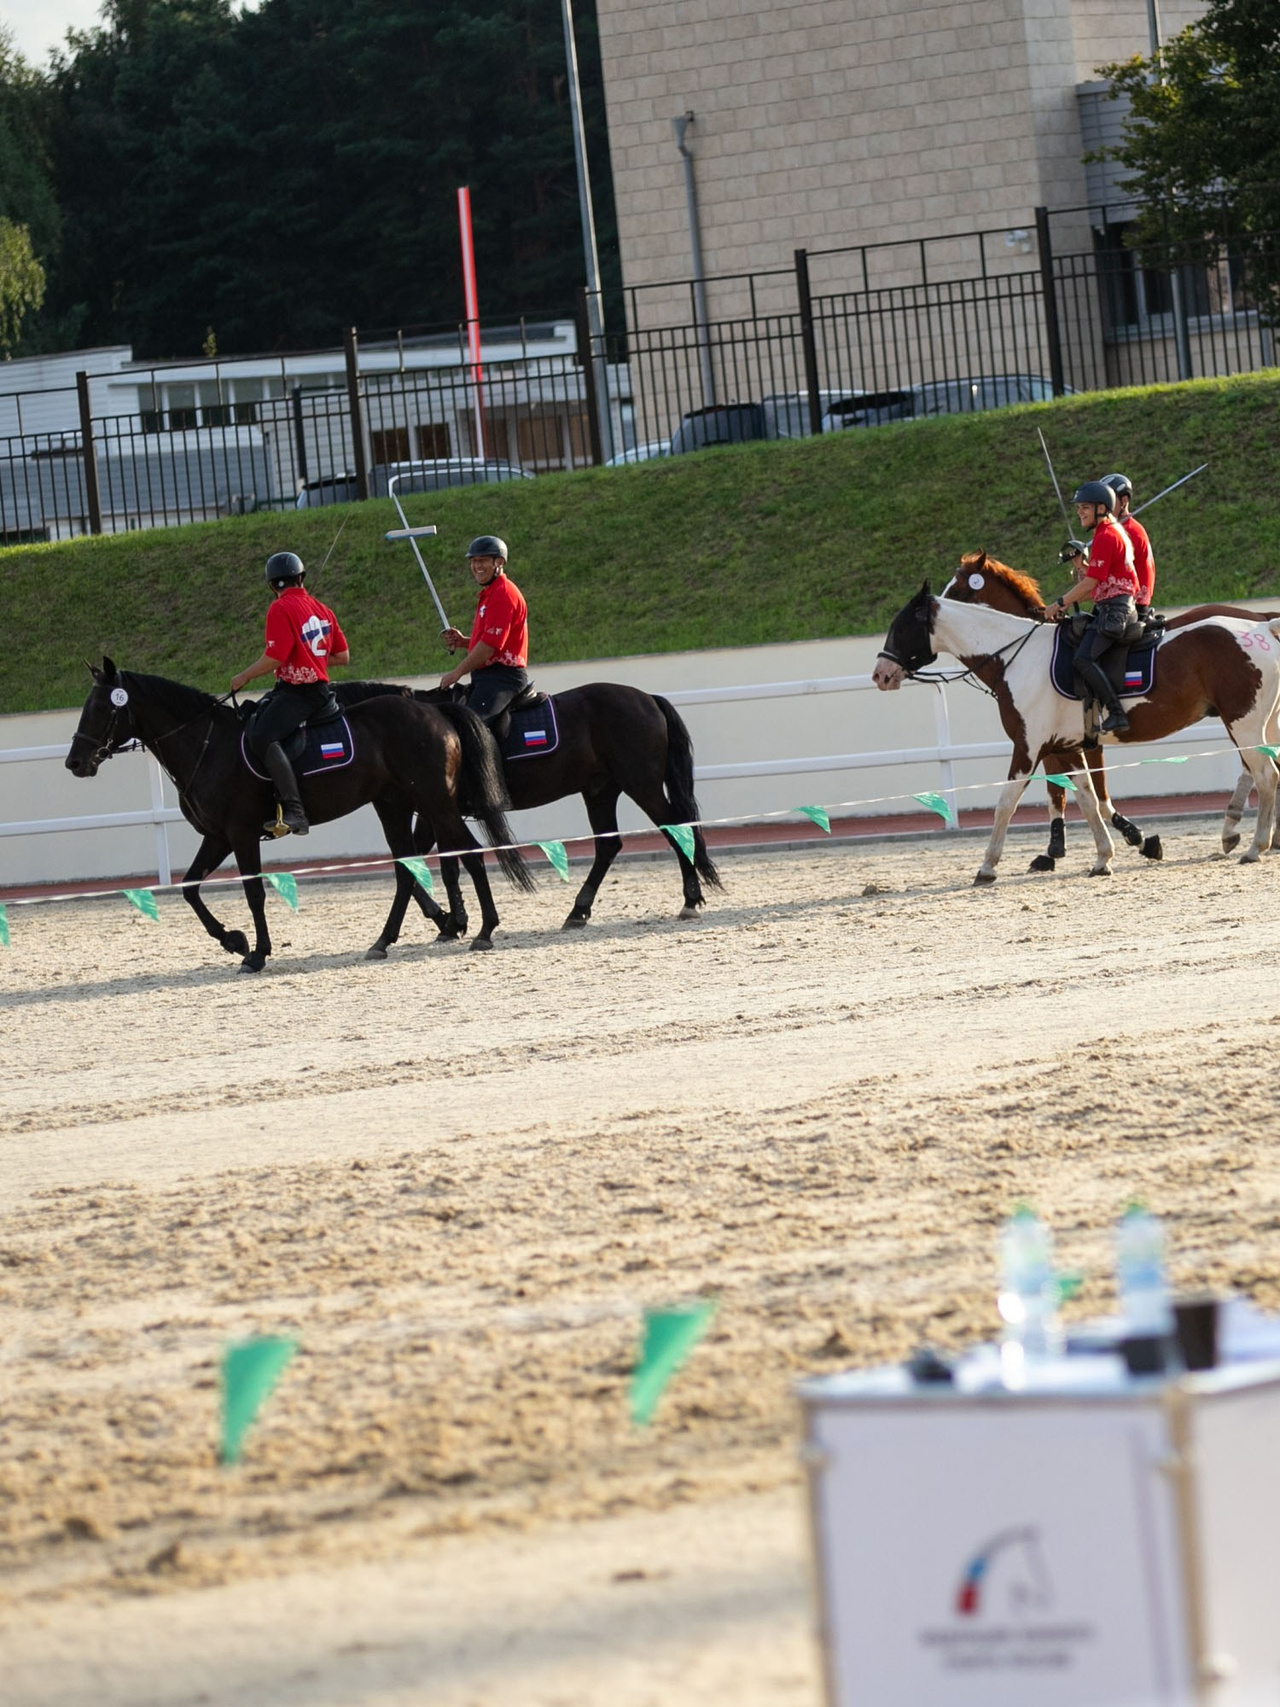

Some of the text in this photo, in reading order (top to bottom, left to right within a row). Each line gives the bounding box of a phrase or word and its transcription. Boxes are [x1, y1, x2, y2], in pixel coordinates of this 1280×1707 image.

[307, 615, 327, 656] 2
[1236, 631, 1271, 651] 38
[115, 693, 125, 702] 16
